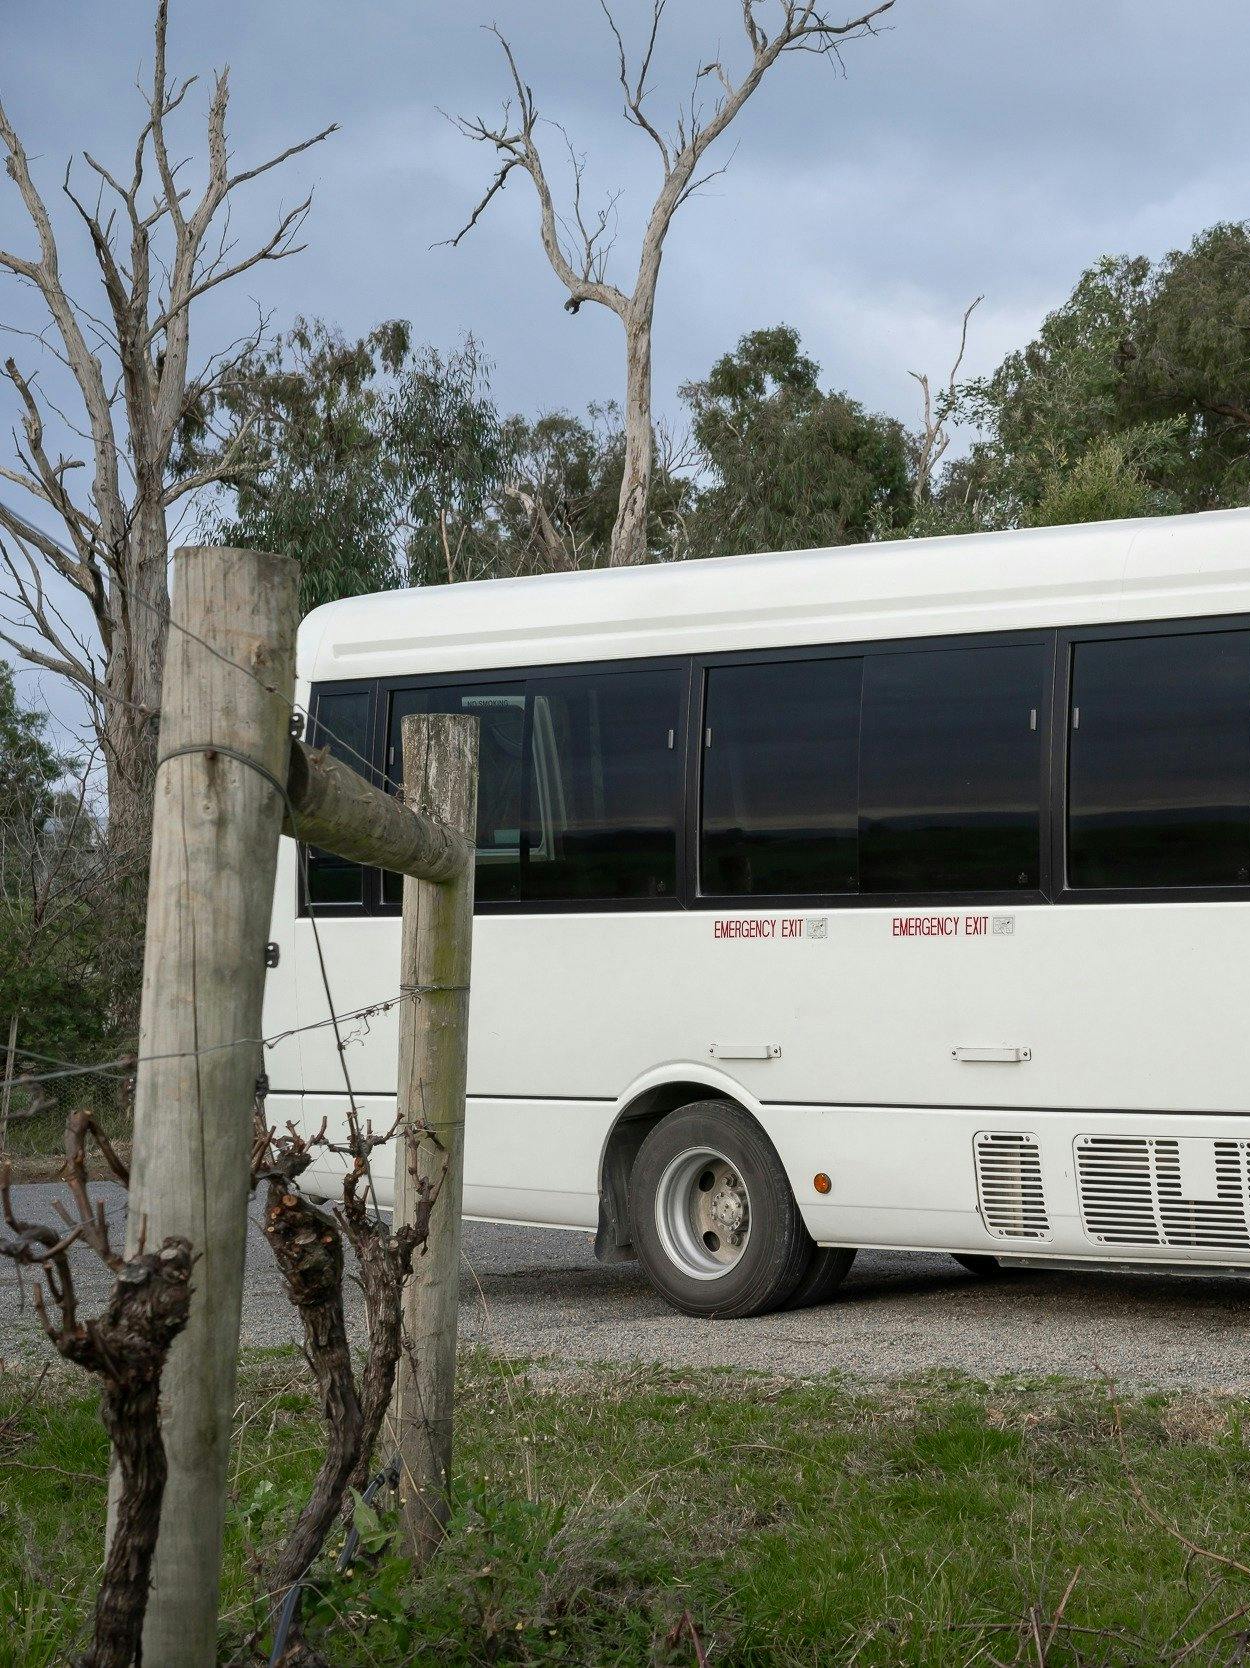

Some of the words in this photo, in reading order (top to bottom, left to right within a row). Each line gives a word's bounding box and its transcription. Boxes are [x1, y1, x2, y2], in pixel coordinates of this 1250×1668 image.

[714, 920, 776, 938] EMERGENCY
[781, 918, 803, 938] EXIT
[892, 917, 959, 936] EMERGENCY
[965, 916, 988, 936] EXIT
